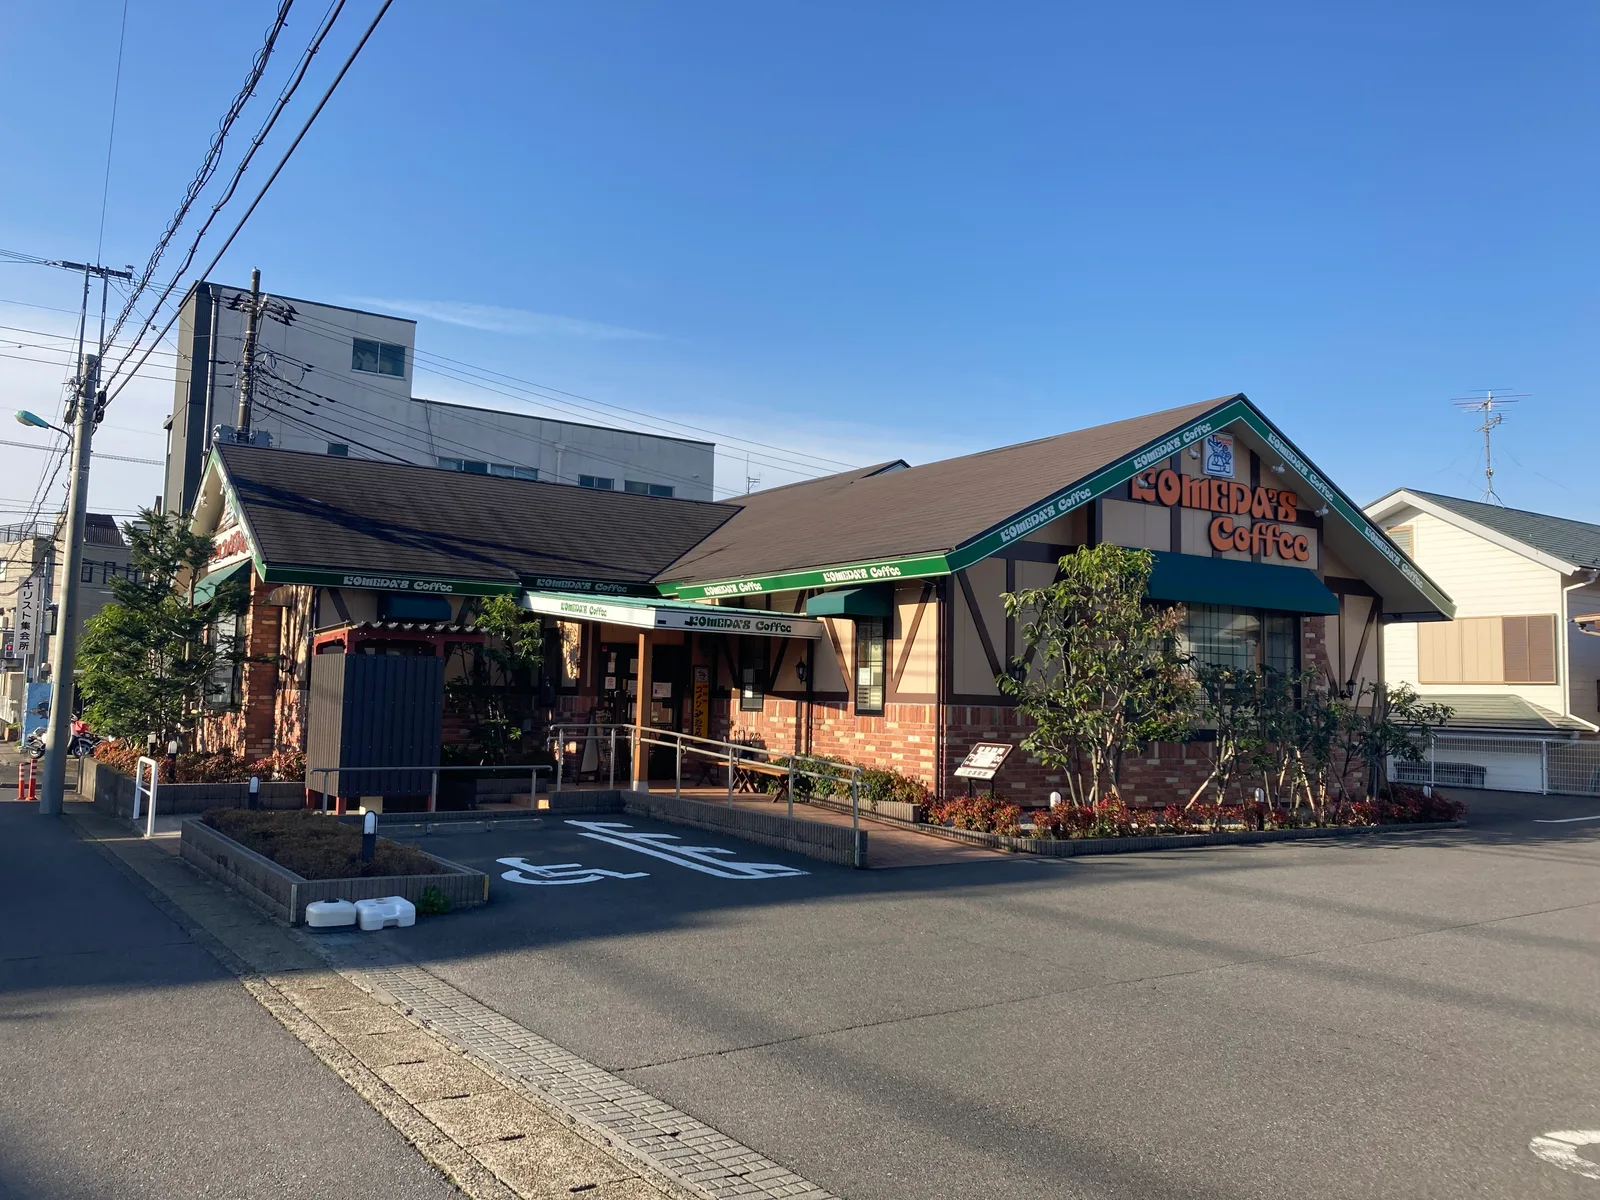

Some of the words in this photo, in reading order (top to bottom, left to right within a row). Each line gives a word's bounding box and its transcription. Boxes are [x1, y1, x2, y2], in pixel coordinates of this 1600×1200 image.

[1133, 437, 1181, 469] KOMEDA'S
[1183, 423, 1212, 443] Coffee
[1268, 433, 1308, 476] KOMEDA'S
[1309, 474, 1334, 501] Coffee
[1000, 504, 1056, 542] KOMEDA'S
[1058, 487, 1091, 510] Coffee
[1130, 467, 1298, 523] KOMEDA'S
[1209, 516, 1310, 562] Coffee
[1365, 526, 1401, 566] KOMEDA'S
[1401, 561, 1424, 589] Coffee
[343, 576, 410, 589] KOMEDA'S
[413, 581, 453, 592] Coffee
[536, 578, 592, 590] KOMEDA'S
[595, 583, 628, 593] Coffee
[704, 584, 738, 595] KOMEDA'S
[739, 581, 763, 592] Coffee
[823, 568, 868, 582] KOMEDA'S
[870, 565, 901, 578] Coffee
[18, 580, 33, 651] キリスト集会所
[560, 602, 588, 614] KOMEDA'S
[589, 605, 608, 617] Coffee
[688, 615, 751, 630] KOMEDA'S
[755, 621, 792, 633] Coffee
